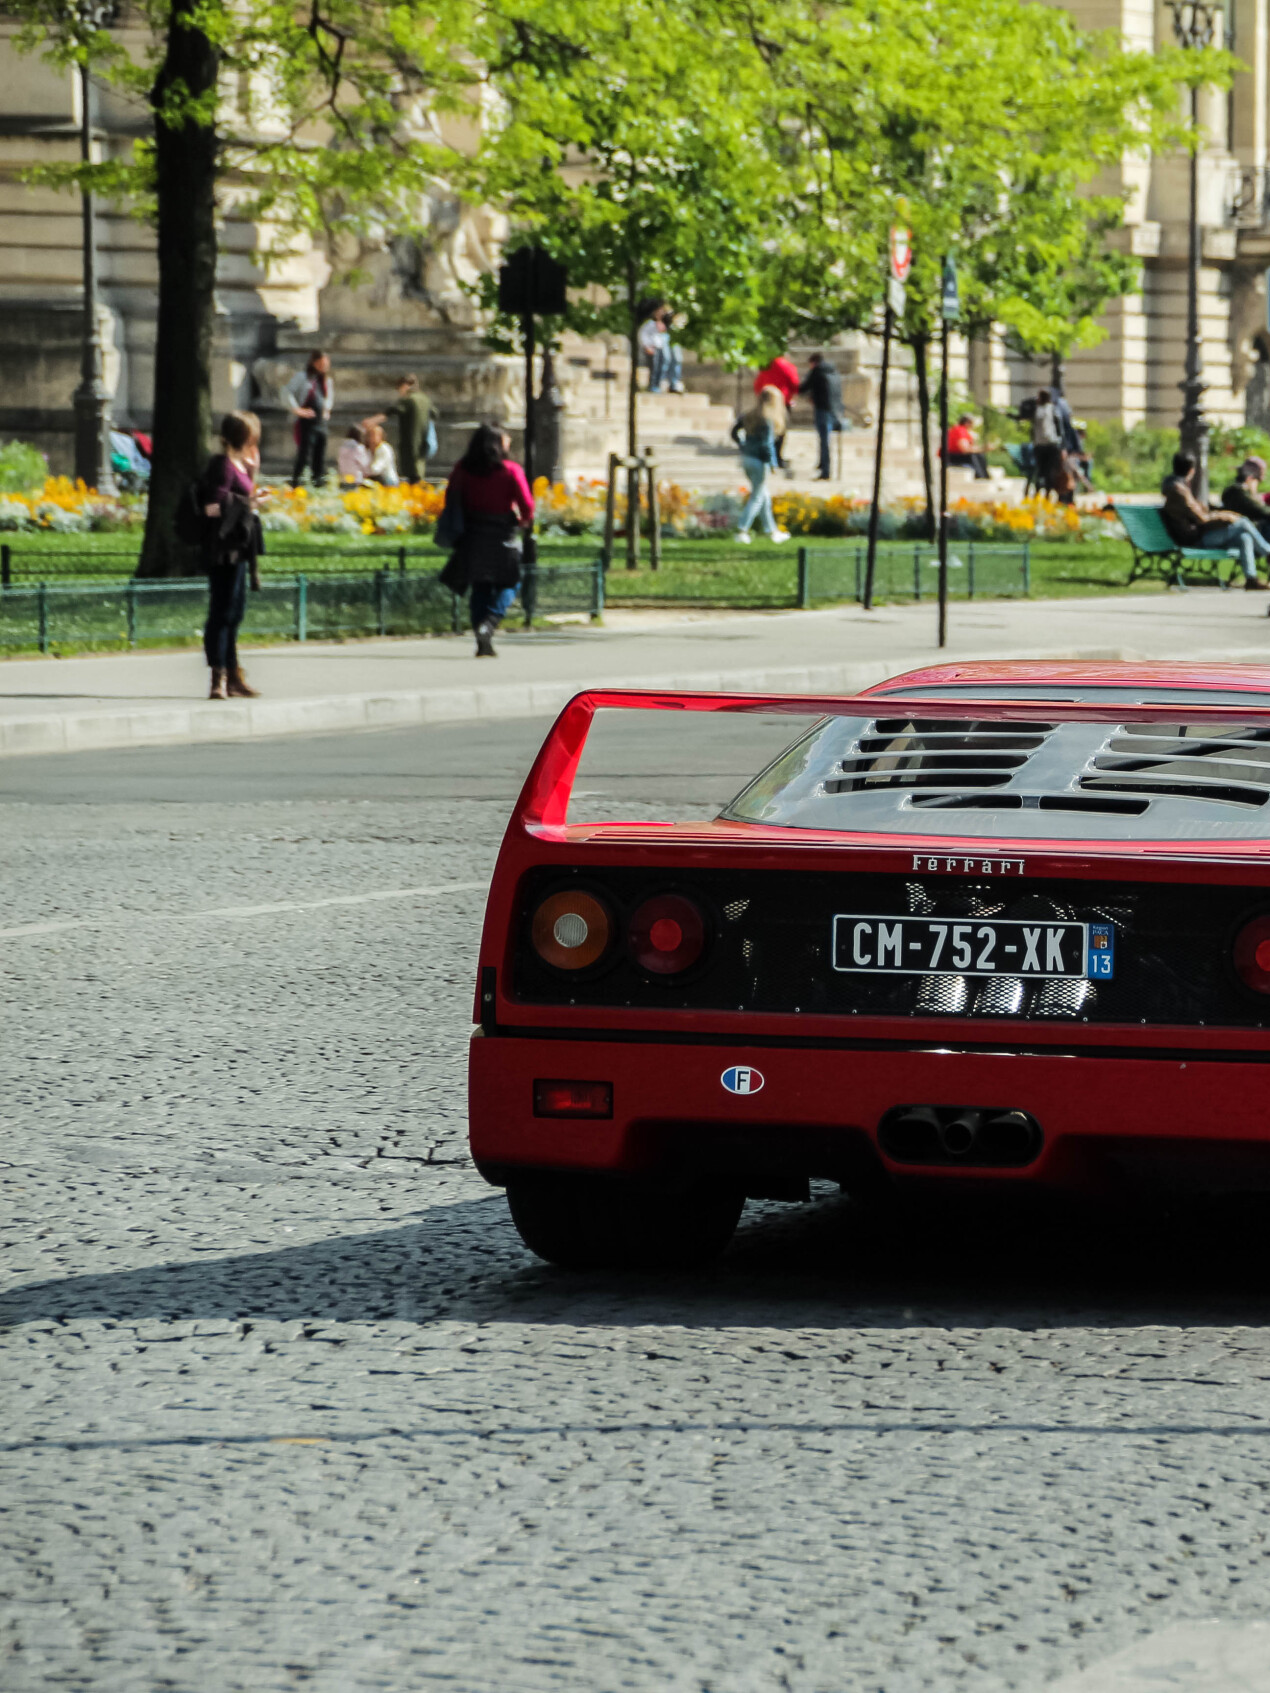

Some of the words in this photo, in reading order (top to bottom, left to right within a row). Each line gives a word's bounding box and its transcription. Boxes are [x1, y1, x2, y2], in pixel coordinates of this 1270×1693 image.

[912, 854, 1025, 875] Ferrari
[853, 922, 1065, 972] CM-752-XK
[1092, 955, 1111, 973] 13
[737, 1070, 749, 1091] F
